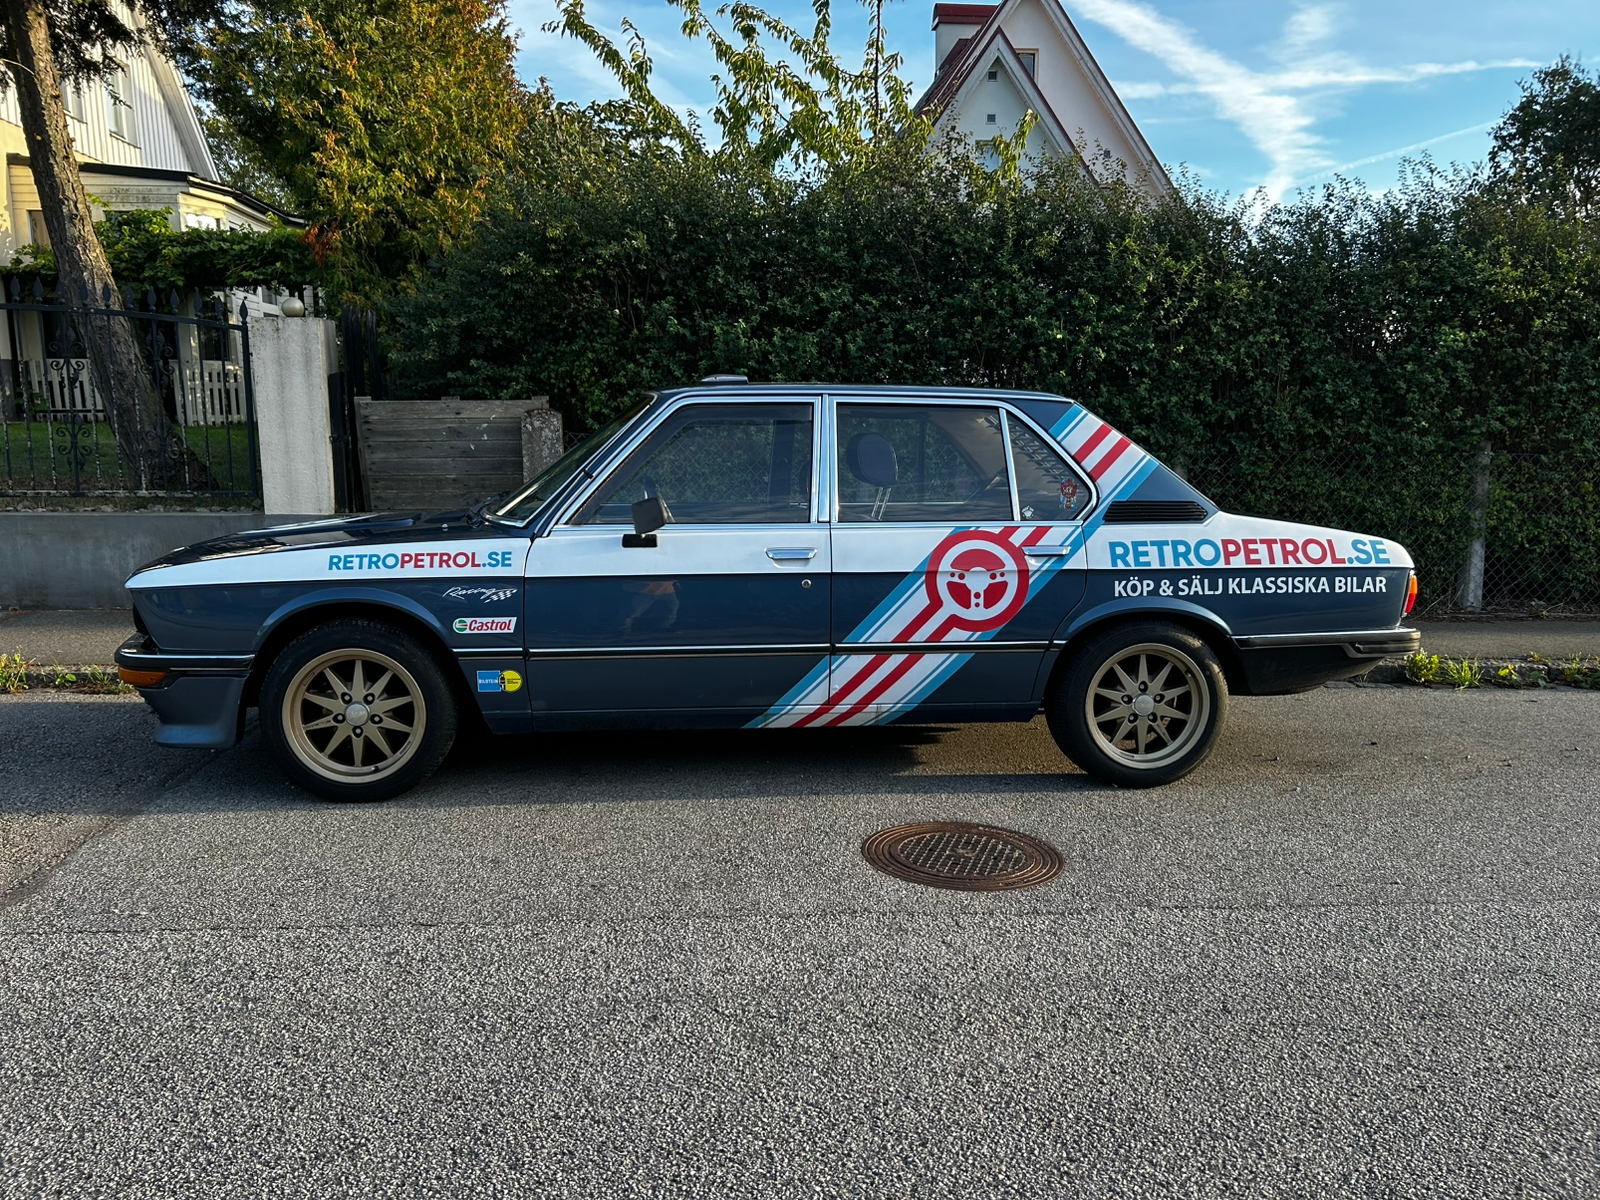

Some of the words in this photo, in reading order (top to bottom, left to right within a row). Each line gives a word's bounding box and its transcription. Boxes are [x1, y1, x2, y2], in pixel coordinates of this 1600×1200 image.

[328, 551, 512, 570] RETROPETROL.SE
[1108, 538, 1391, 567] RETROPETROL.SE
[1114, 576, 1154, 597] KÖP
[1158, 578, 1175, 596] &
[1178, 575, 1223, 596] SÄLJ
[1228, 576, 1330, 594] KLASSISKA
[1334, 576, 1387, 593] BILAR
[468, 619, 512, 632] Castrol
